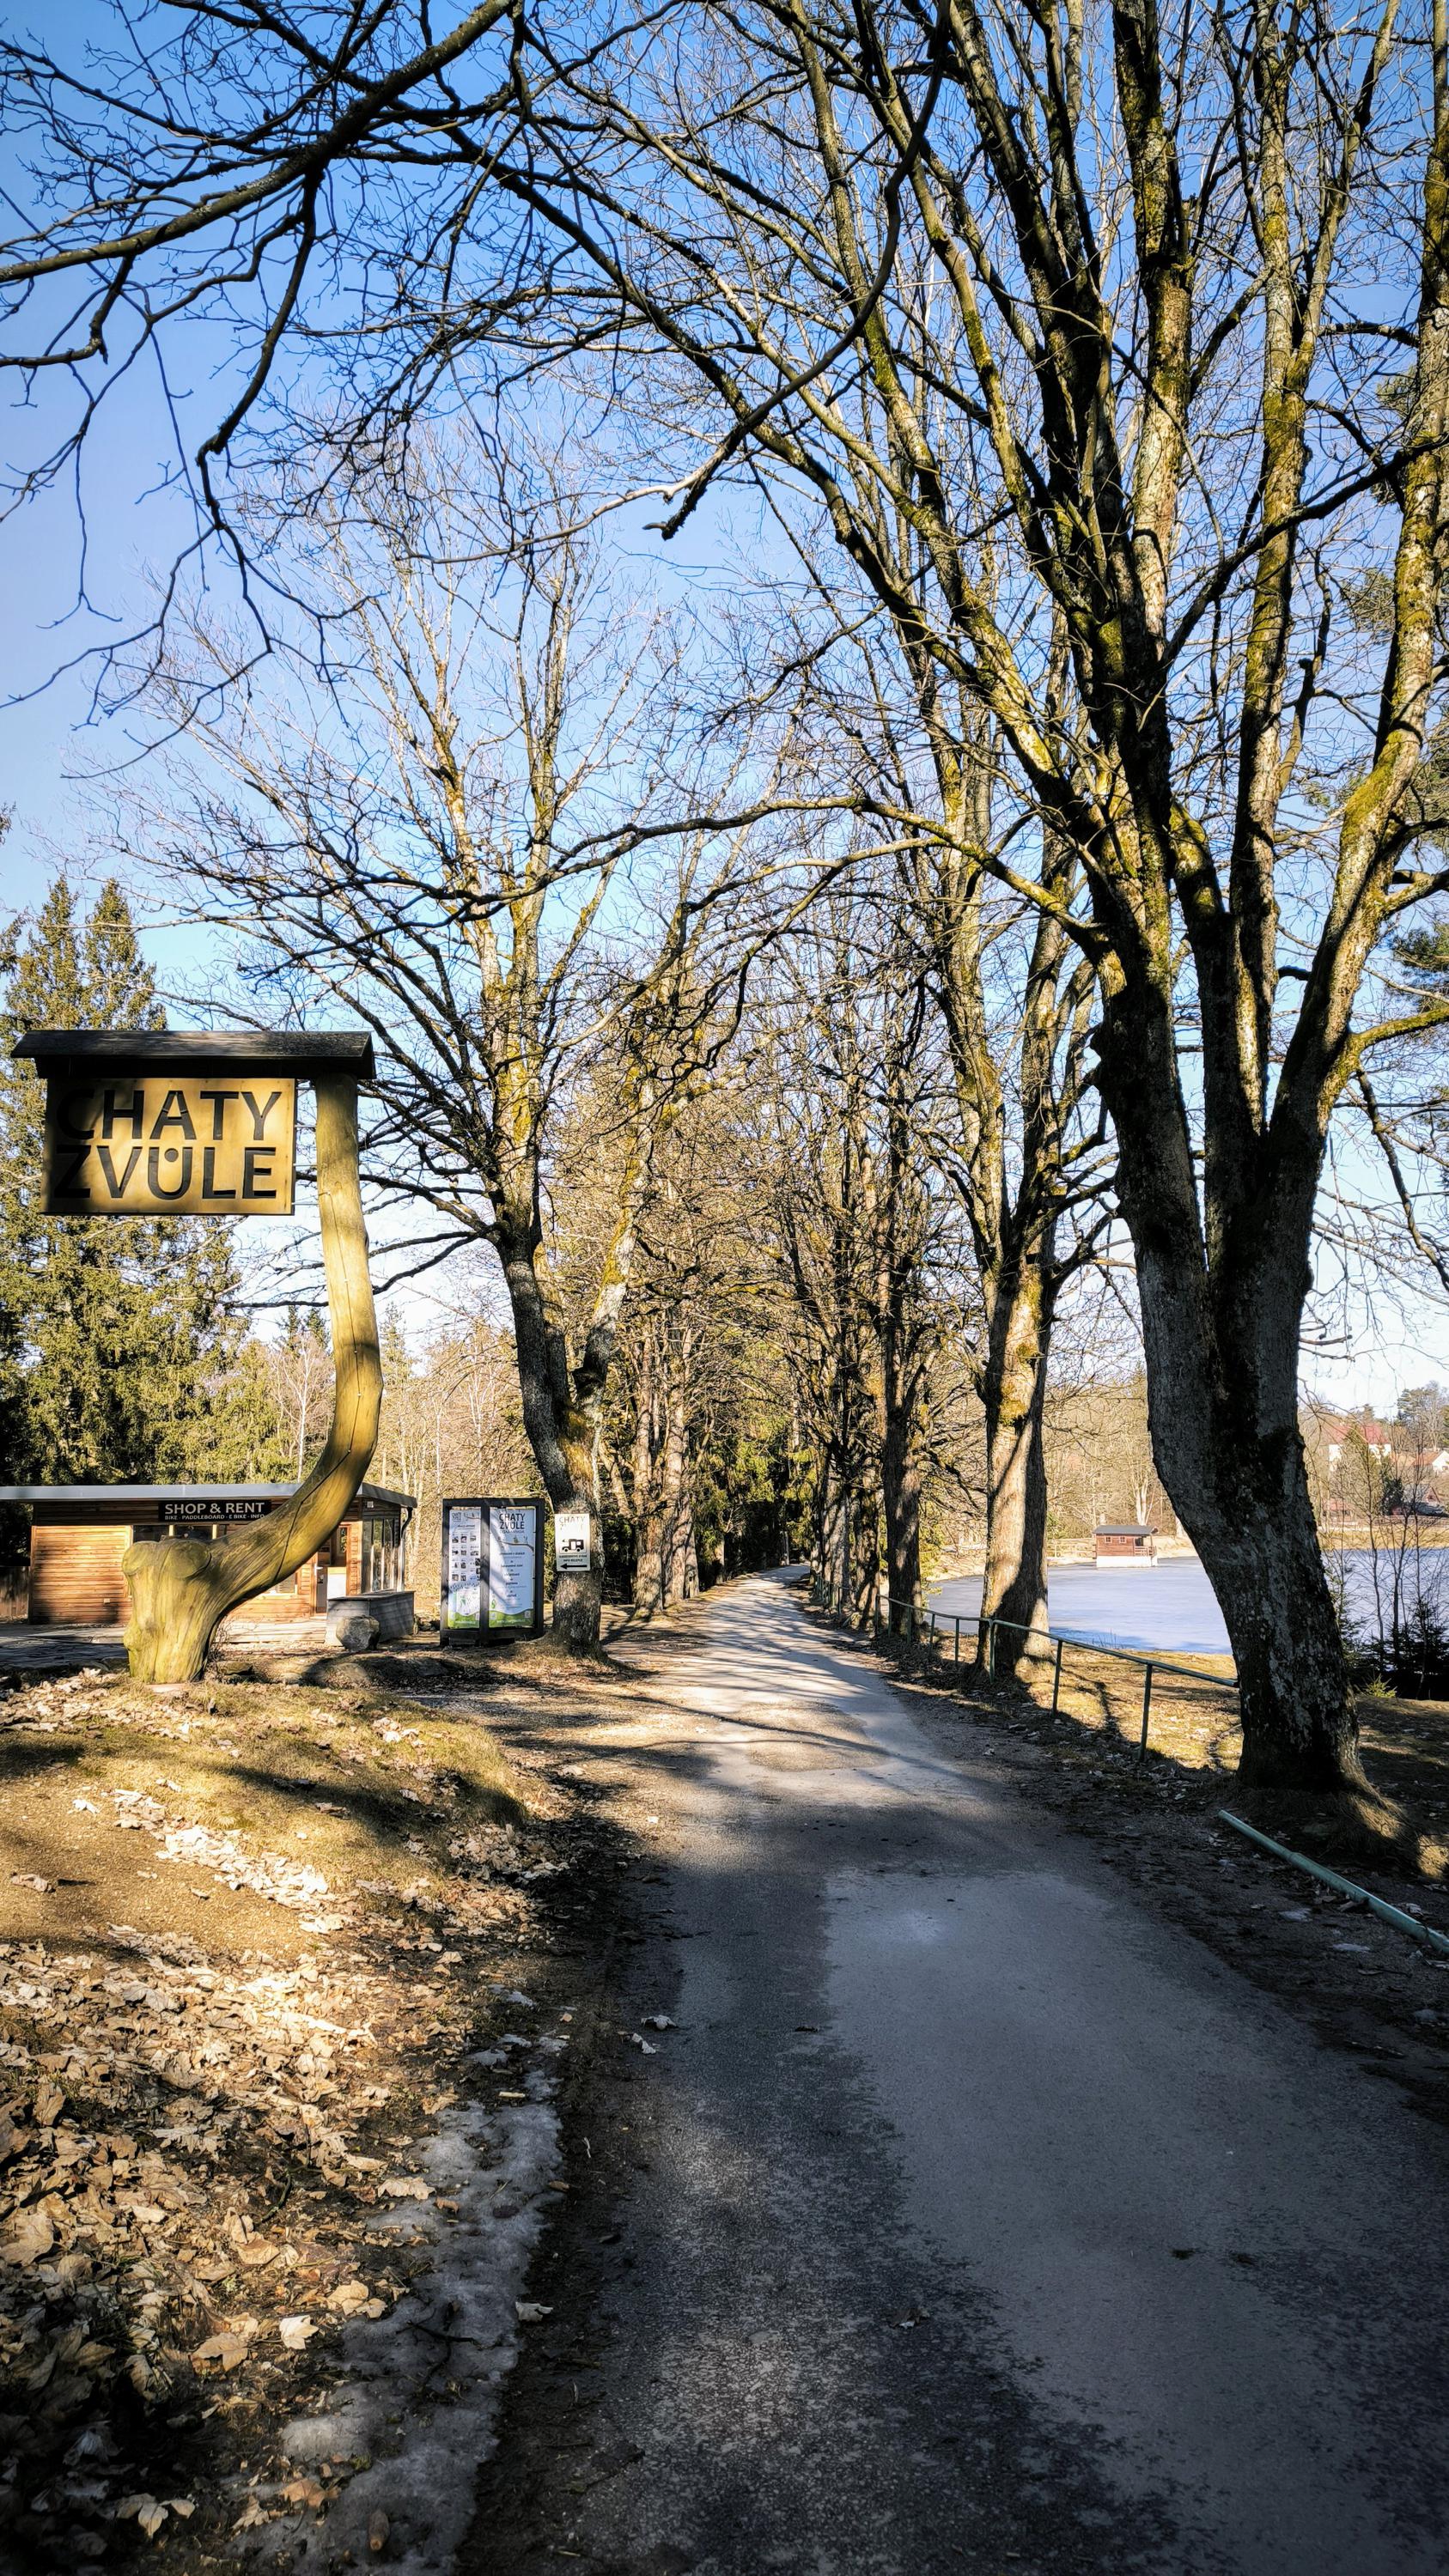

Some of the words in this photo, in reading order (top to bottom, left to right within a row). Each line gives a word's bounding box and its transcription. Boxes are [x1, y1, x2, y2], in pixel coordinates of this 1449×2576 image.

[57, 1088, 283, 1140] CHATY
[54, 1145, 277, 1200] ZVŮLE
[165, 1504, 206, 1515] SHOP
[210, 1503, 221, 1514] &
[226, 1503, 265, 1513] RENT
